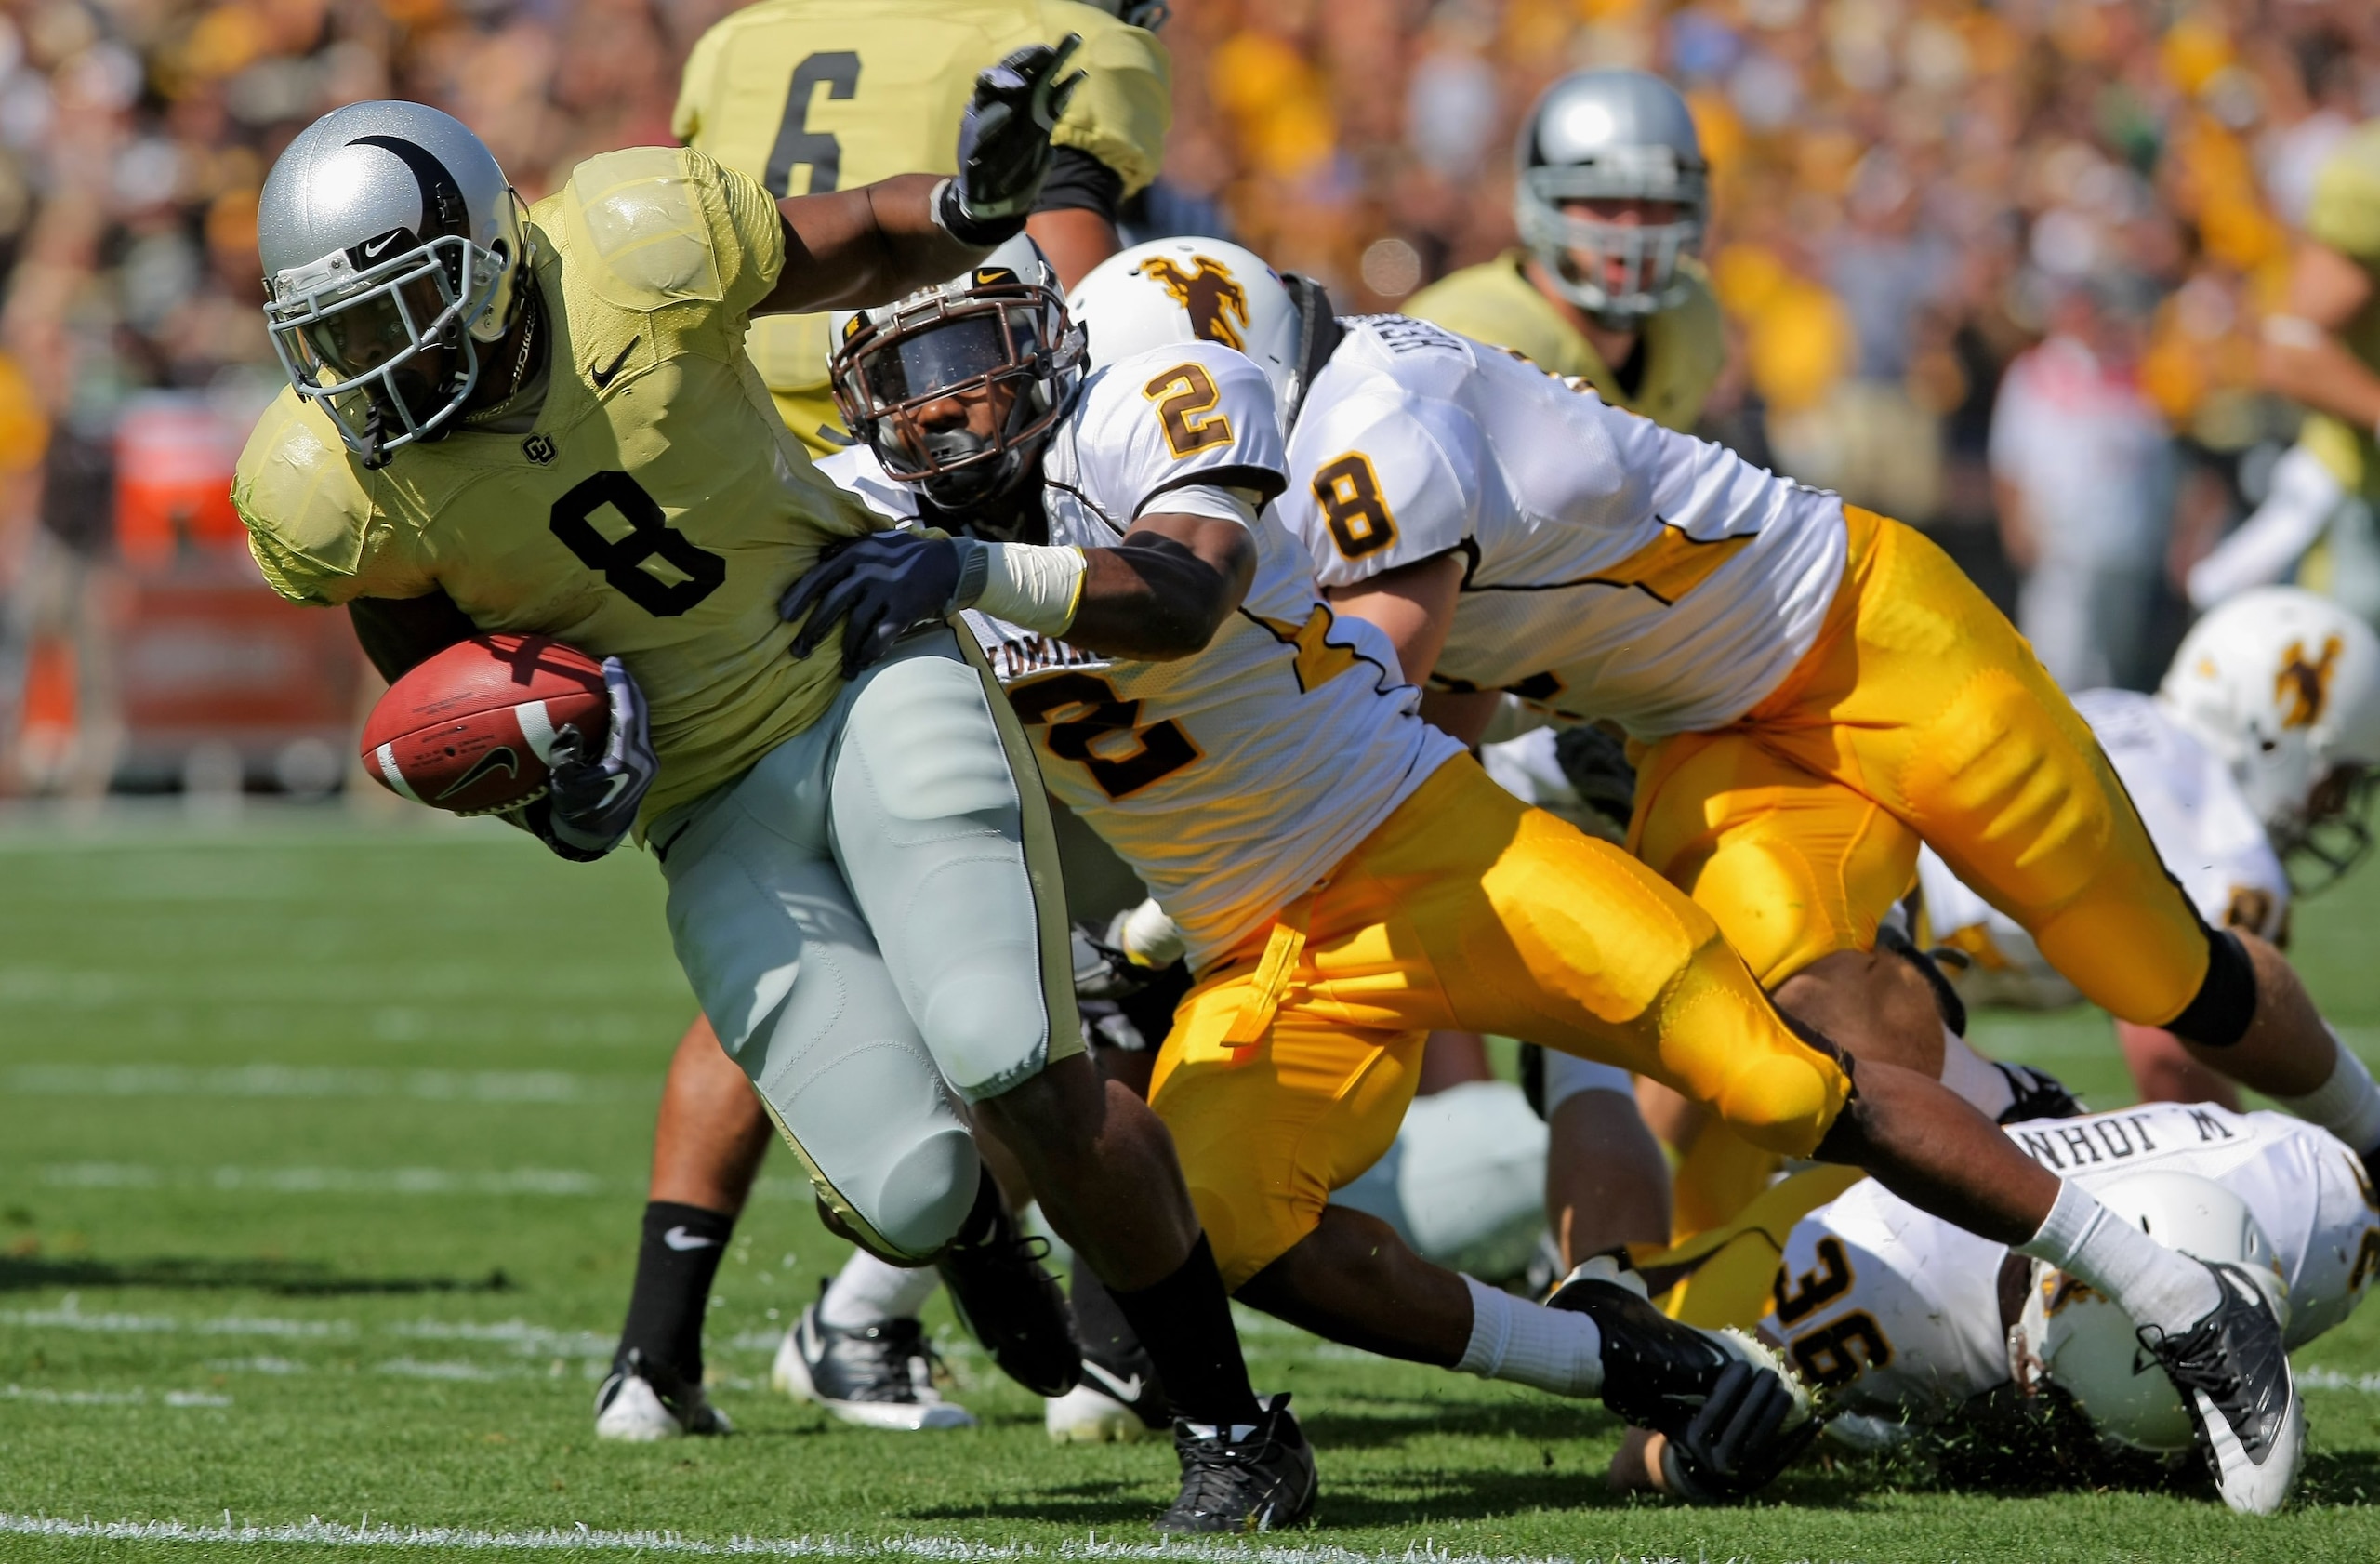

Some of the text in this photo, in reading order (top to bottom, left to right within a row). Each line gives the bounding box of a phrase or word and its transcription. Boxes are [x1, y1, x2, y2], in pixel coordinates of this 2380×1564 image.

[764, 51, 862, 200] 6
[522, 433, 557, 465] CU
[1142, 362, 1235, 459] 2
[549, 470, 726, 617] 8
[1310, 450, 1399, 563] 8
[1006, 670, 1207, 803] 2
[1774, 1235, 1895, 1389] 36
